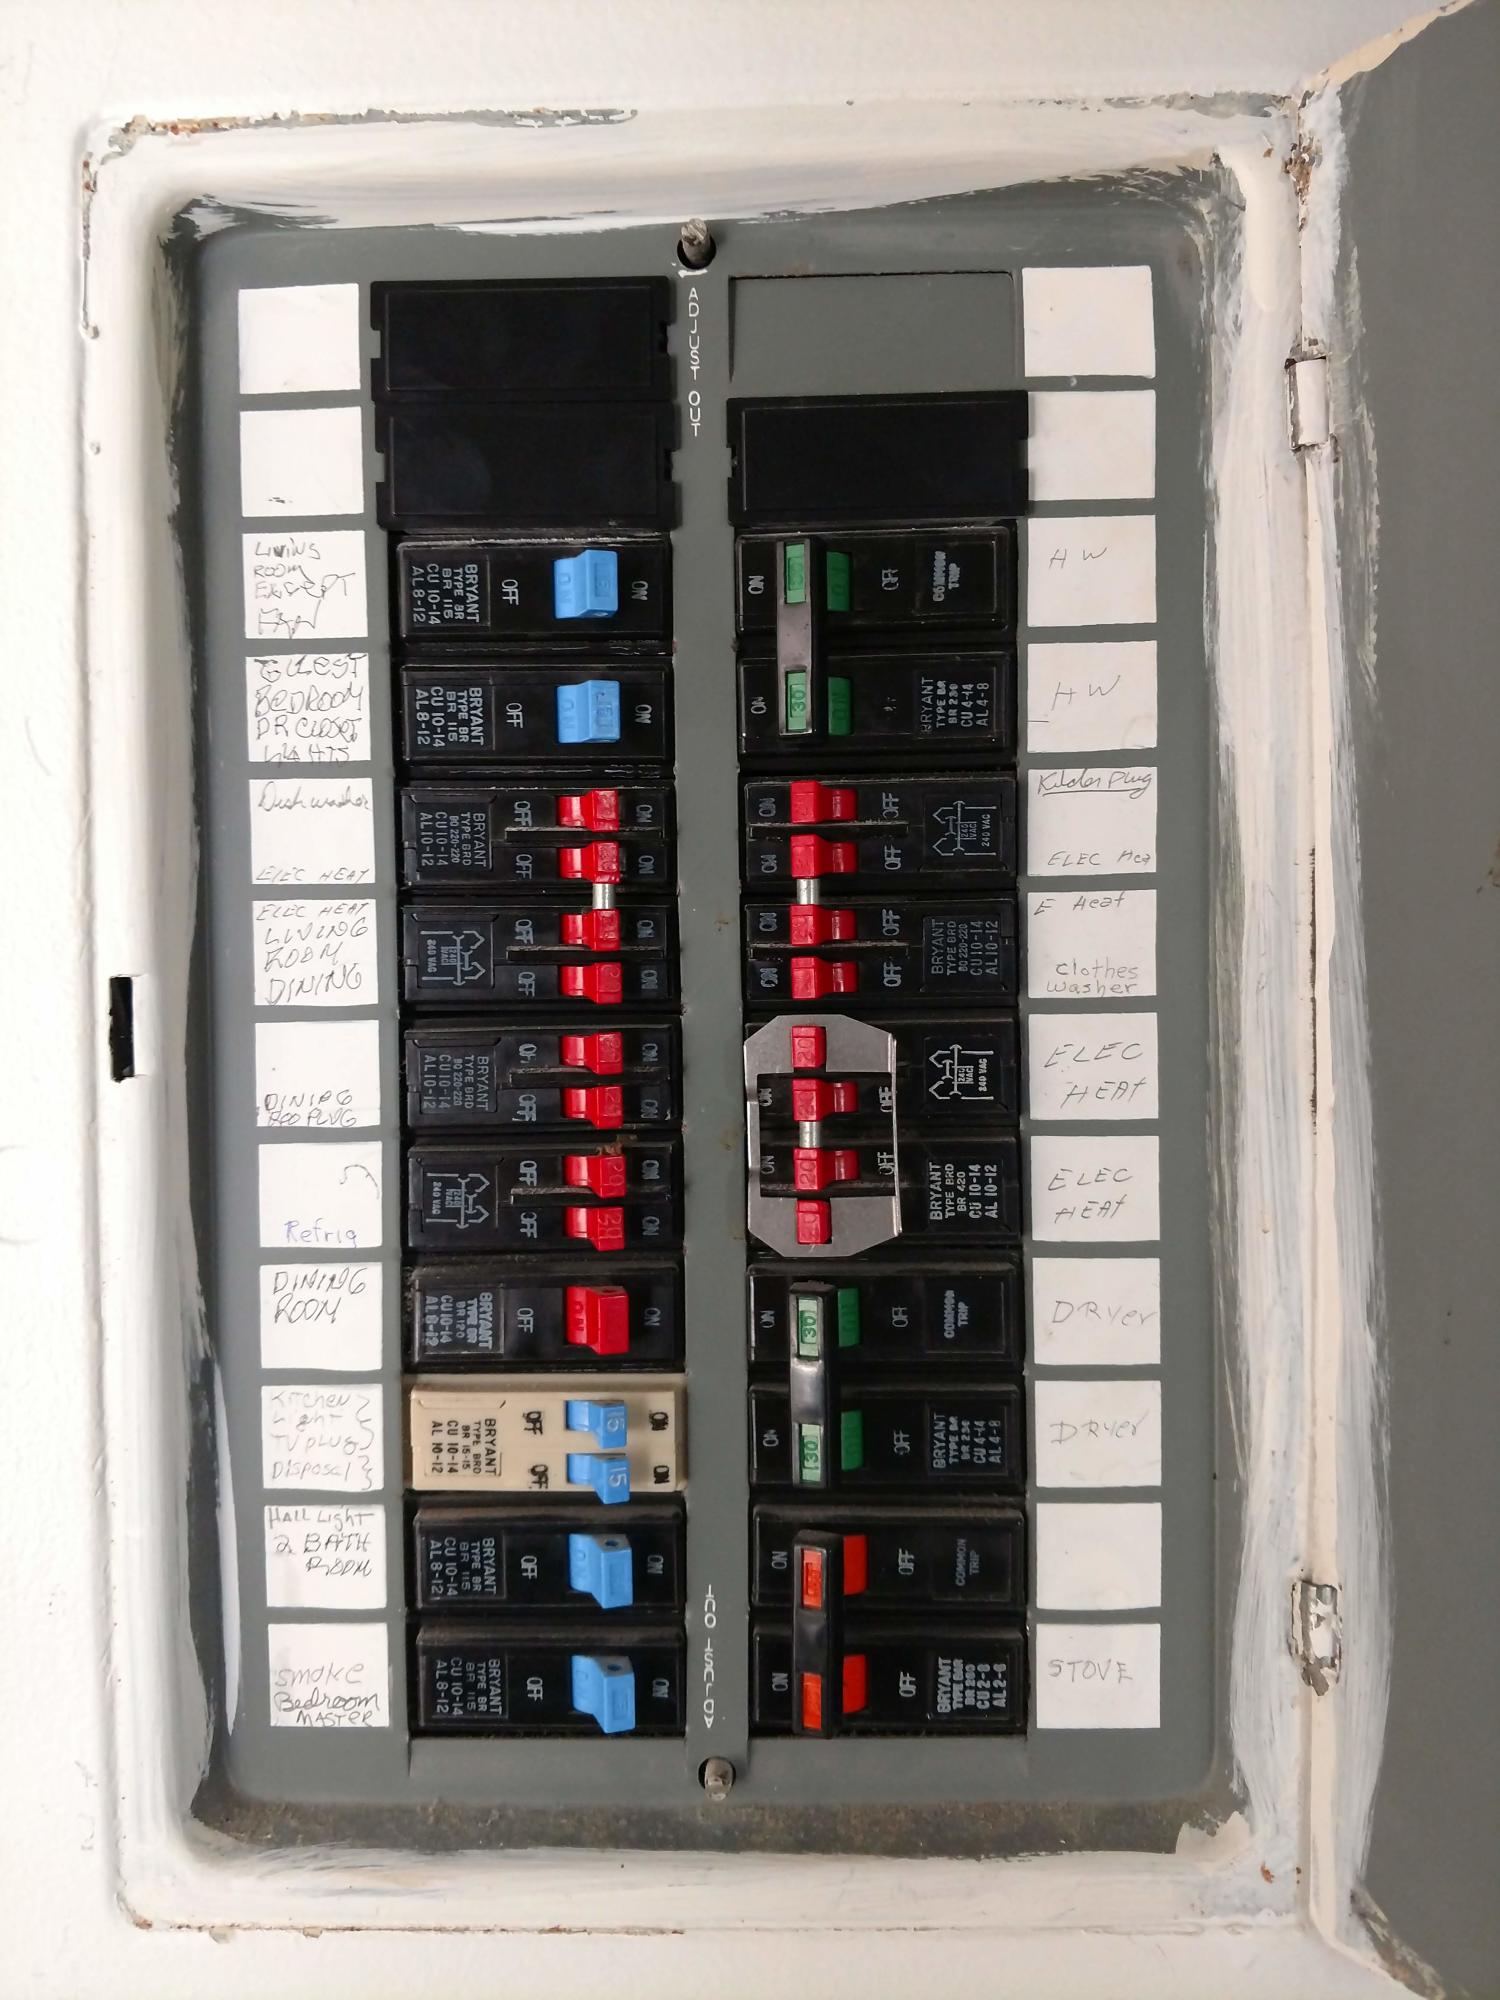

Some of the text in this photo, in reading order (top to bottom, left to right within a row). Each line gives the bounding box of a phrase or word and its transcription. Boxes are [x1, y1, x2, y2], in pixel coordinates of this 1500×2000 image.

[688, 287, 701, 437] ADJUST OUT
[427, 564, 441, 625] CU 10-14
[453, 567, 463, 597] TYPE
[465, 564, 480, 623] BRYANT
[501, 579, 518, 605] OFF
[431, 686, 445, 747] CU 10-14
[457, 690, 468, 720] TYPE
[469, 687, 484, 745] BRYANT
[505, 703, 523, 728] OFF
[635, 704, 652, 724] ON
[937, 697, 946, 728] TYPE
[961, 711, 973, 727] CU
[514, 801, 531, 826] OFF
[883, 792, 899, 819] OFF
[461, 812, 470, 839] TYPE
[450, 829, 460, 863] 220-220
[472, 813, 486, 867] BRYANT
[516, 854, 533, 879] OFF
[884, 845, 901, 870] OFF
[1048, 851, 1101, 866] ELEC
[882, 909, 900, 936] OFF
[931, 919, 945, 974] BRYANT
[884, 961, 901, 987] OFF
[947, 948, 957, 975] TYPE
[518, 971, 535, 996] OFF
[1044, 1042, 1144, 1068] ELEC
[464, 1055, 474, 1083] TYPE
[477, 1056, 489, 1111] BRYANT
[519, 1160, 537, 1186] OFF
[969, 1164, 982, 1197] 10-14
[1048, 1168, 1133, 1191] ELEC
[930, 1162, 942, 1220] BRYANT
[945, 1163, 955, 1218] TYPE BRD
[957, 1171, 967, 1211] BR 420
[985, 1164, 998, 1218] AL 10-12
[274, 1292, 341, 1324] ROOM
[479, 1292, 493, 1349] BRYANT
[517, 1308, 533, 1333] OFF
[644, 1308, 660, 1326] ON
[805, 1315, 816, 1339] 30
[471, 1422, 481, 1446] TYPE
[523, 1411, 543, 1435] OFF
[607, 1413, 625, 1432] 15
[432, 1420, 443, 1473] AL 10-12
[447, 1420, 458, 1473] CU 10-14
[462, 1425, 470, 1470] BR 15-15
[485, 1419, 497, 1476] BRYANT
[804, 1440, 819, 1465] 30
[933, 1413, 946, 1469] BRYANT
[608, 1467, 627, 1487] 15
[460, 1543, 468, 1563] BR
[471, 1542, 481, 1570] TYPE
[482, 1538, 497, 1594] BRYANT
[772, 1551, 788, 1570] ON
[898, 1549, 915, 1575] OFF
[969, 1550, 980, 1575] TRIP
[444, 1538, 458, 1596] CU 10-14
[521, 1556, 538, 1579] OFF
[477, 1662, 487, 1690] TYPE
[772, 1672, 788, 1692] ON
[899, 1671, 916, 1697] OFF
[1049, 1658, 1133, 1683] STOVE
[451, 1657, 463, 1716] CU 10-14
[489, 1659, 502, 1715] BRYANT
[526, 1677, 543, 1701] OFF
[653, 1678, 669, 1698] ON
[937, 1656, 951, 1713] BRYANT
[274, 1687, 380, 1712] Bedroom
